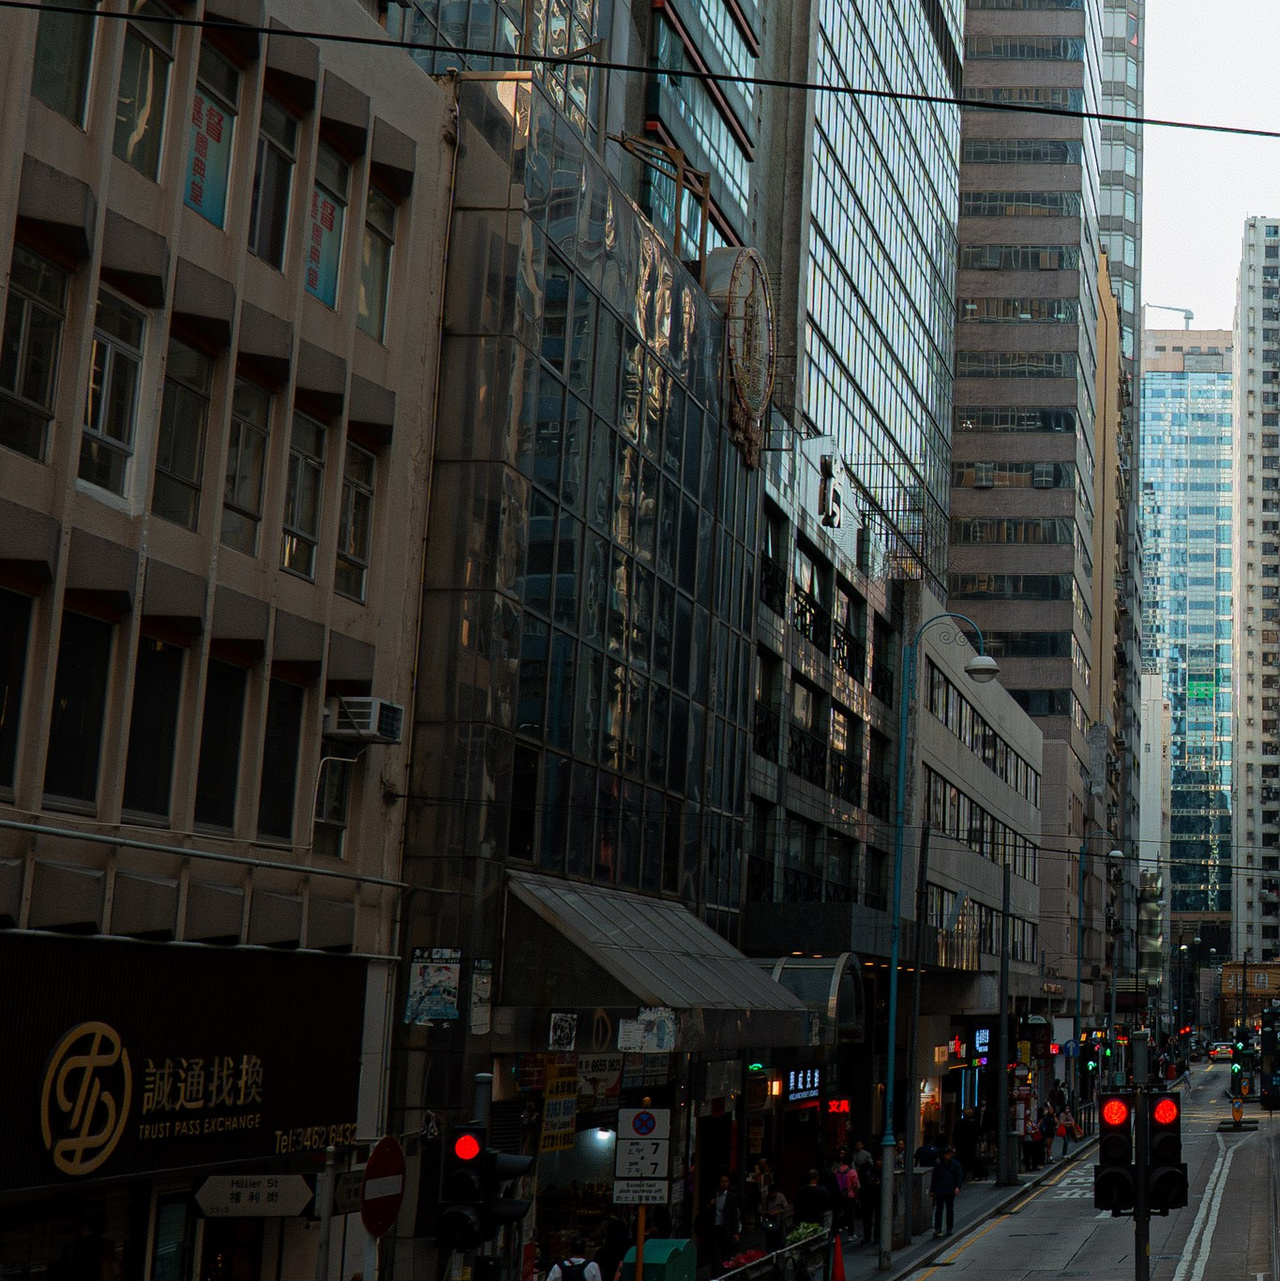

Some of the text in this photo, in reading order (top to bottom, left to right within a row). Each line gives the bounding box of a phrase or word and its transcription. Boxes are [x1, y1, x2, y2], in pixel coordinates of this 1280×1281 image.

[143, 1054, 264, 1116] 誠通找換
[829, 1100, 850, 1113] 文具
[139, 1114, 261, 1141] TRUST PASS EXCHANGE
[651, 1142, 660, 1155] 7
[650, 1162, 659, 1175] 7
[231, 1179, 279, 1189] Hillier St
